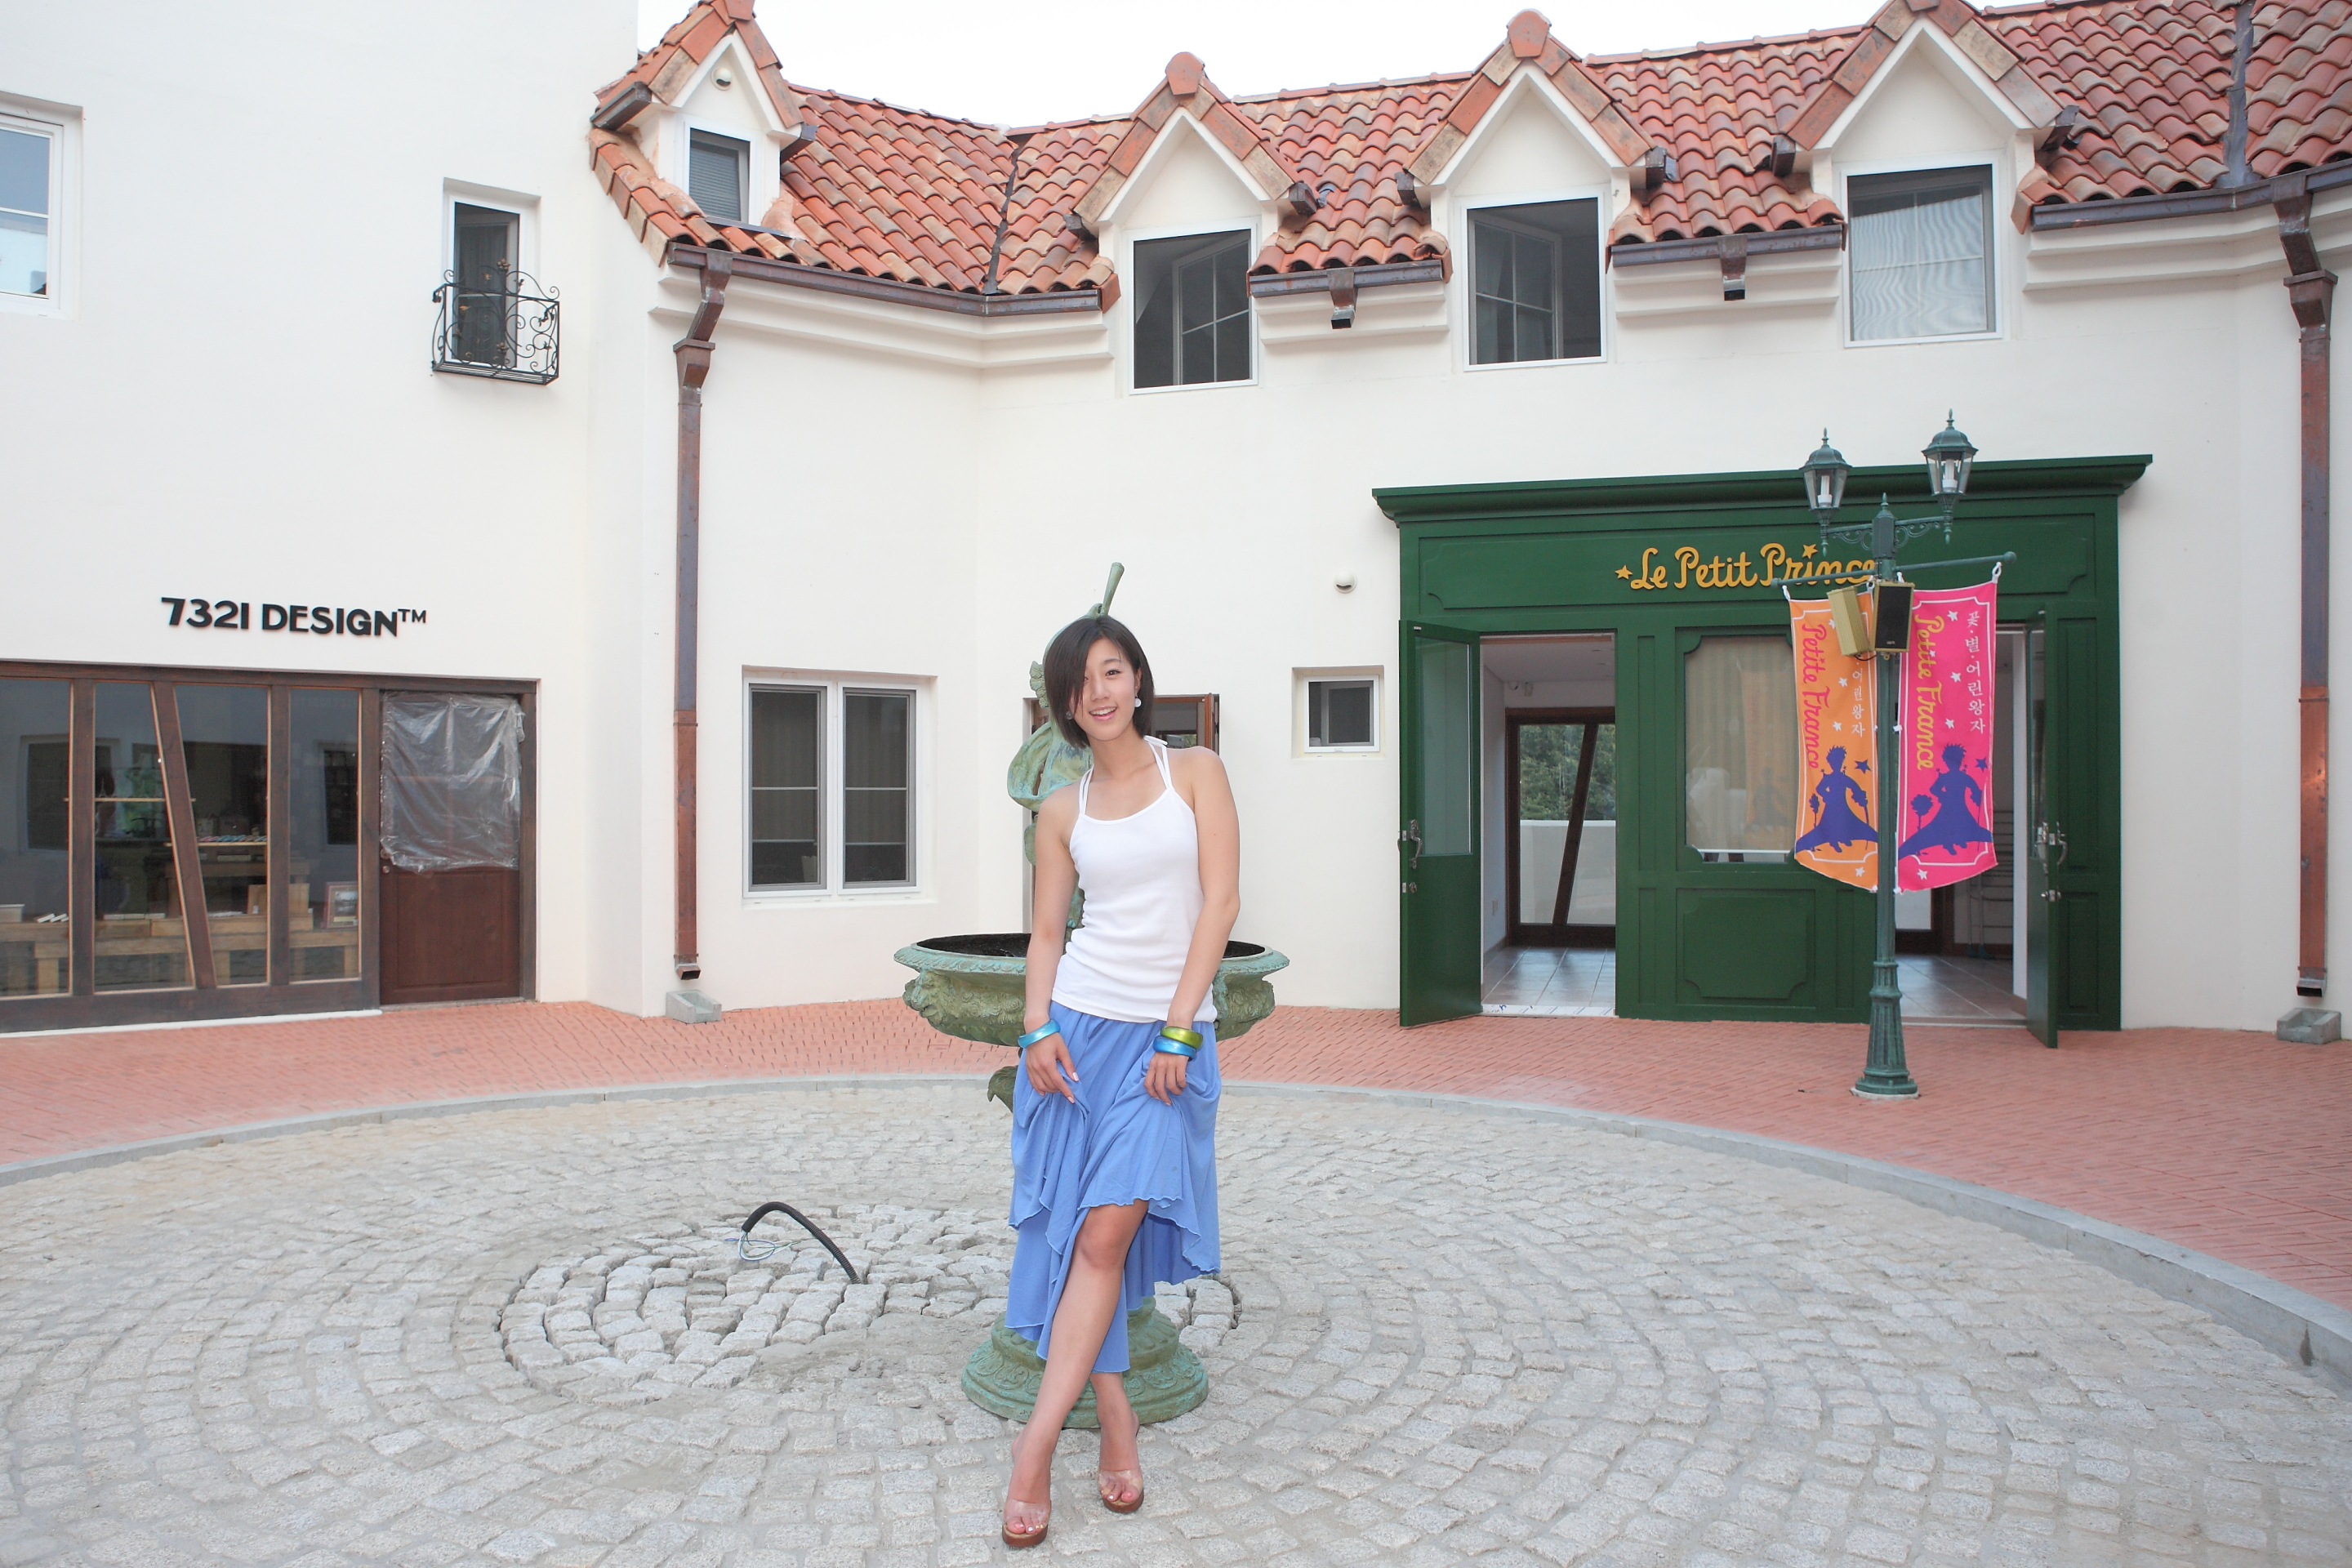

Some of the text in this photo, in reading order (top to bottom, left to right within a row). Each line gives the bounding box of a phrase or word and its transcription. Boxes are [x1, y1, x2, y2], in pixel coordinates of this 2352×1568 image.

[1630, 542, 1875, 590] Le Petit Prince
[1801, 623, 1831, 769] Petite France
[1915, 614, 1945, 770] Petite France
